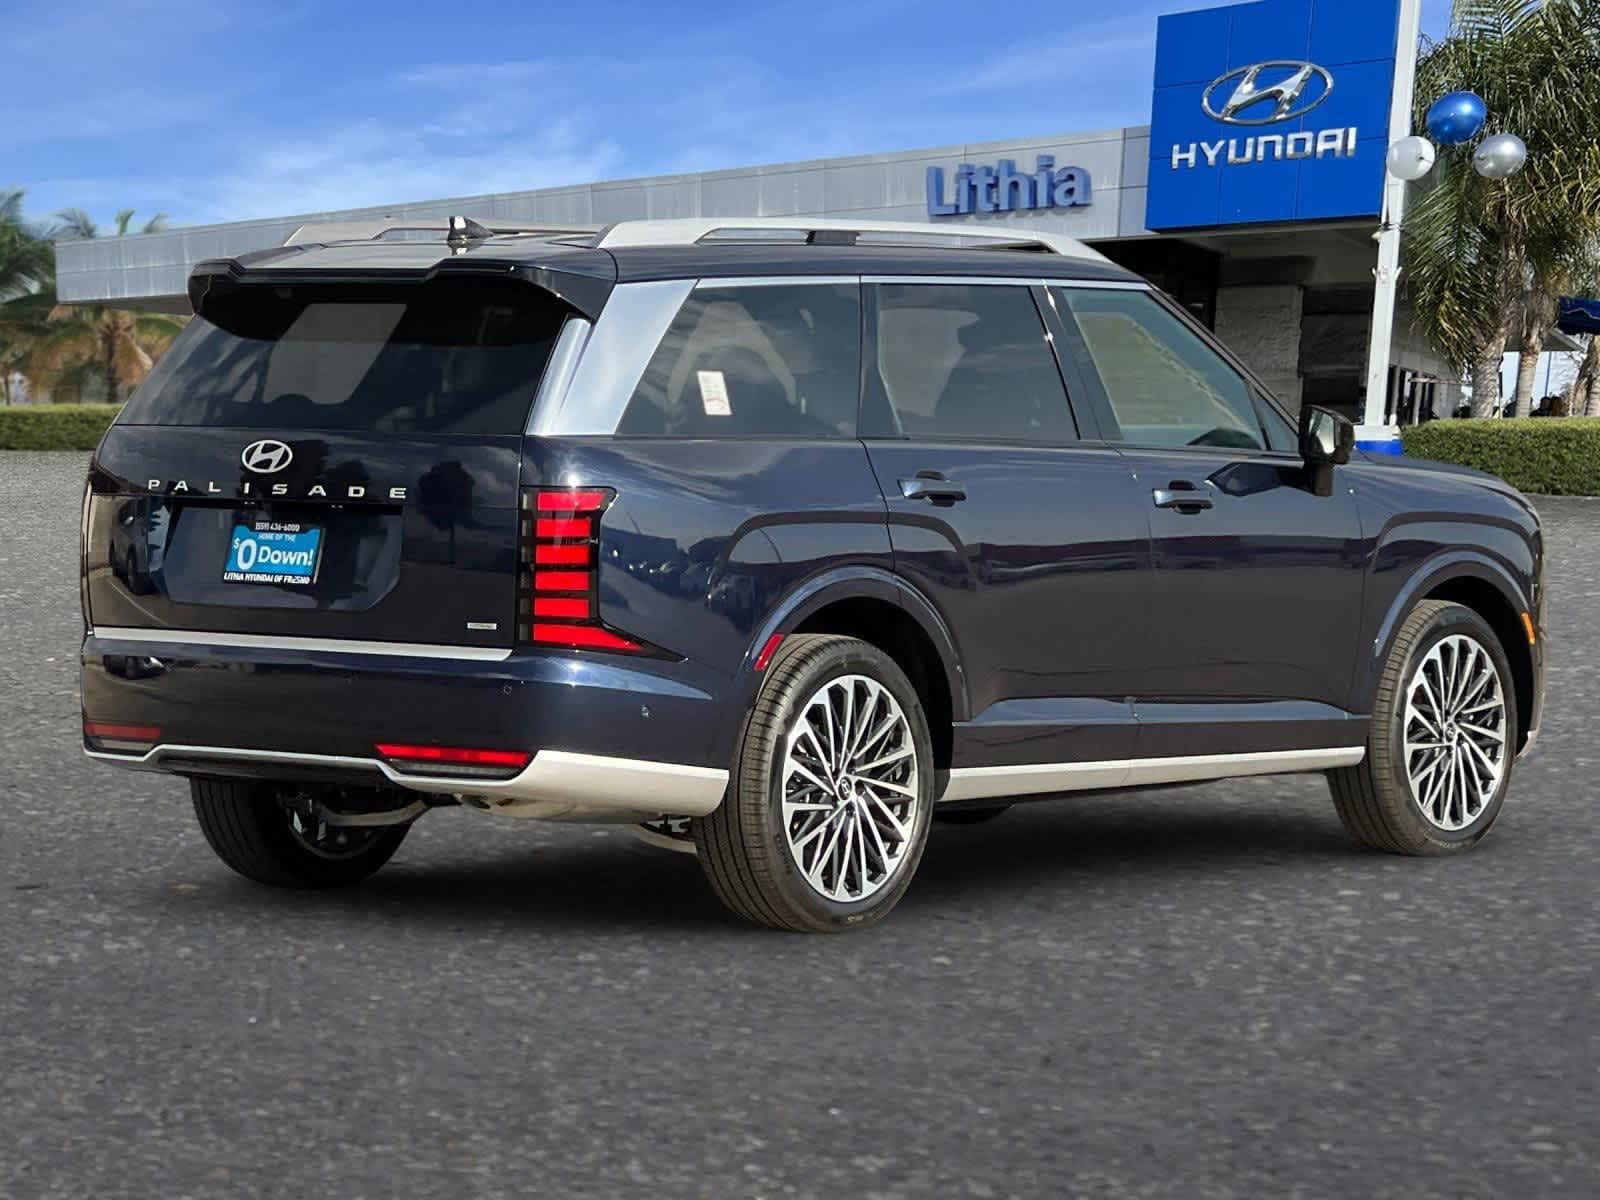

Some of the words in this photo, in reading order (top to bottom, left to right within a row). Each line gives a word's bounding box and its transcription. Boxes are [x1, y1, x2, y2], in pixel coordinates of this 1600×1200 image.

[1170, 126, 1358, 170] HYUNDAI
[925, 154, 1092, 217] Lithia
[147, 479, 408, 499] PALISADE
[257, 532, 274, 541] HOME
[274, 533, 283, 541] OF
[284, 533, 297, 542] THE
[257, 545, 314, 566] Down!
[223, 571, 244, 581] LITHIA
[245, 572, 274, 583] HYUNDAI
[274, 574, 283, 583] OF
